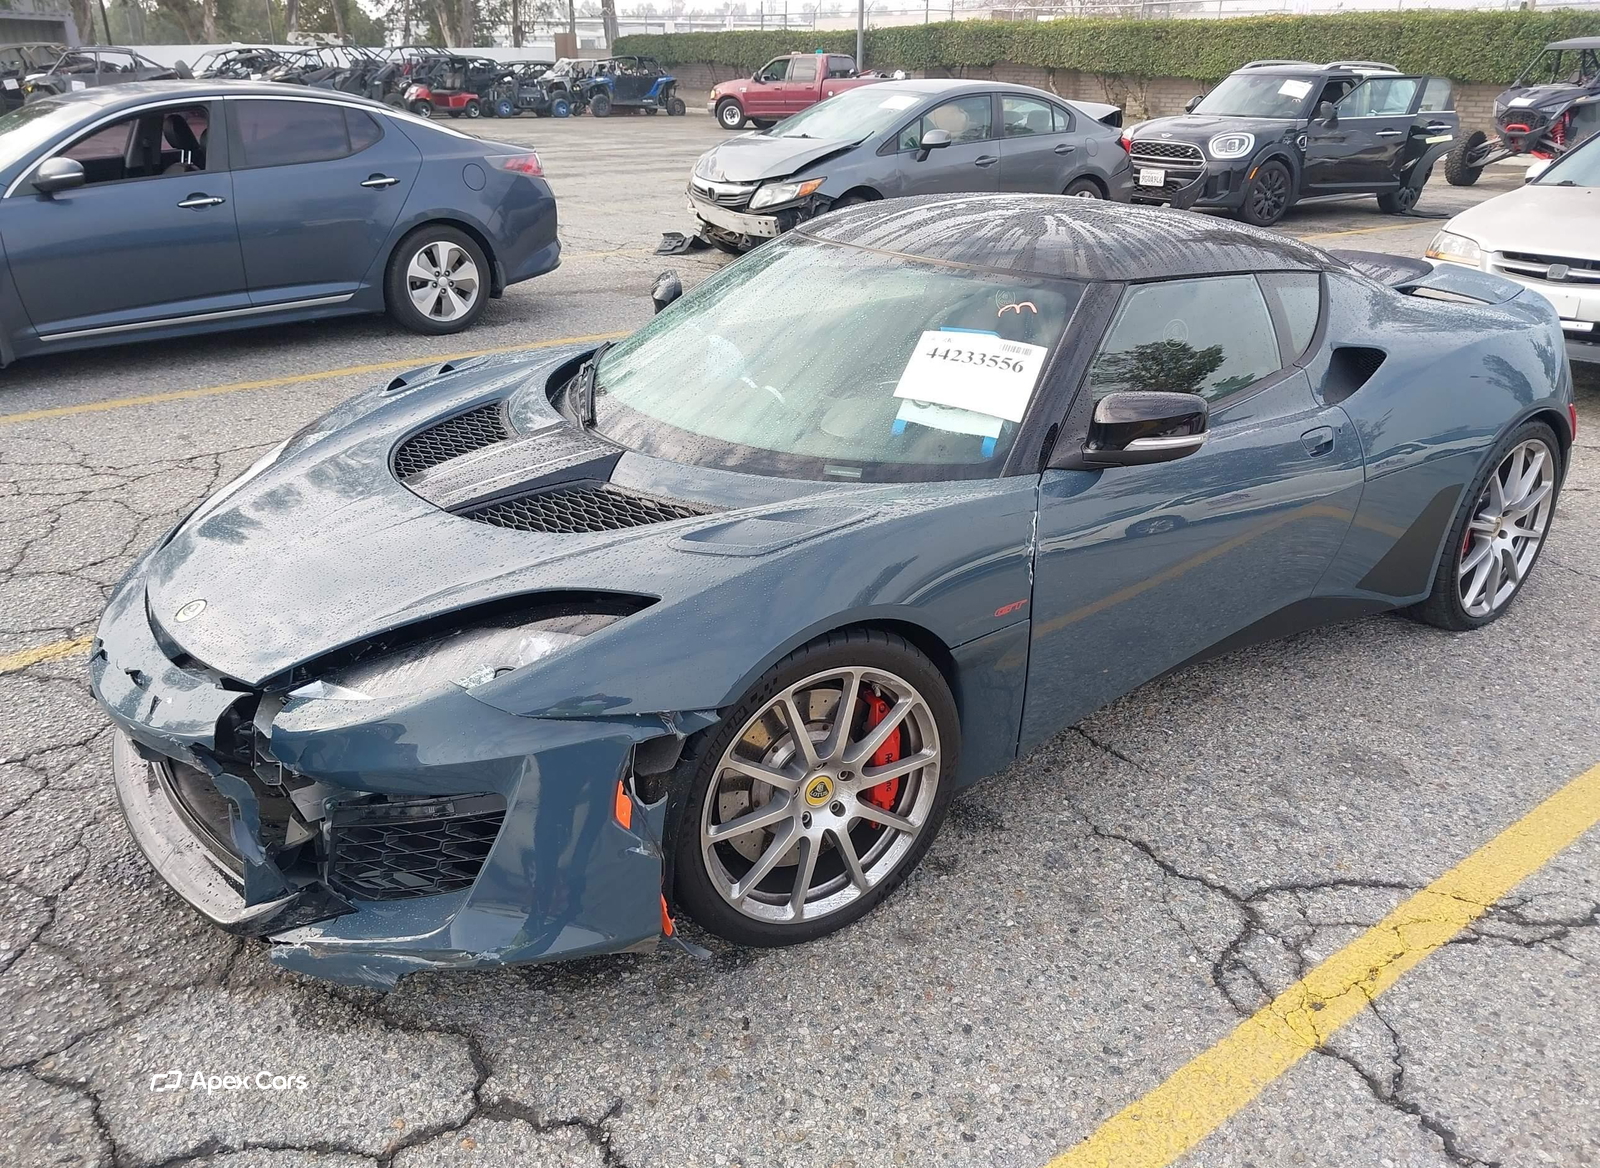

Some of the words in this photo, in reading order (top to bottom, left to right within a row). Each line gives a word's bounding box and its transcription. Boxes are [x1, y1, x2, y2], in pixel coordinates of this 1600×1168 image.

[926, 346, 1025, 373] 44233556
[994, 599, 1028, 617] GT
[810, 790, 828, 798] LOTUS
